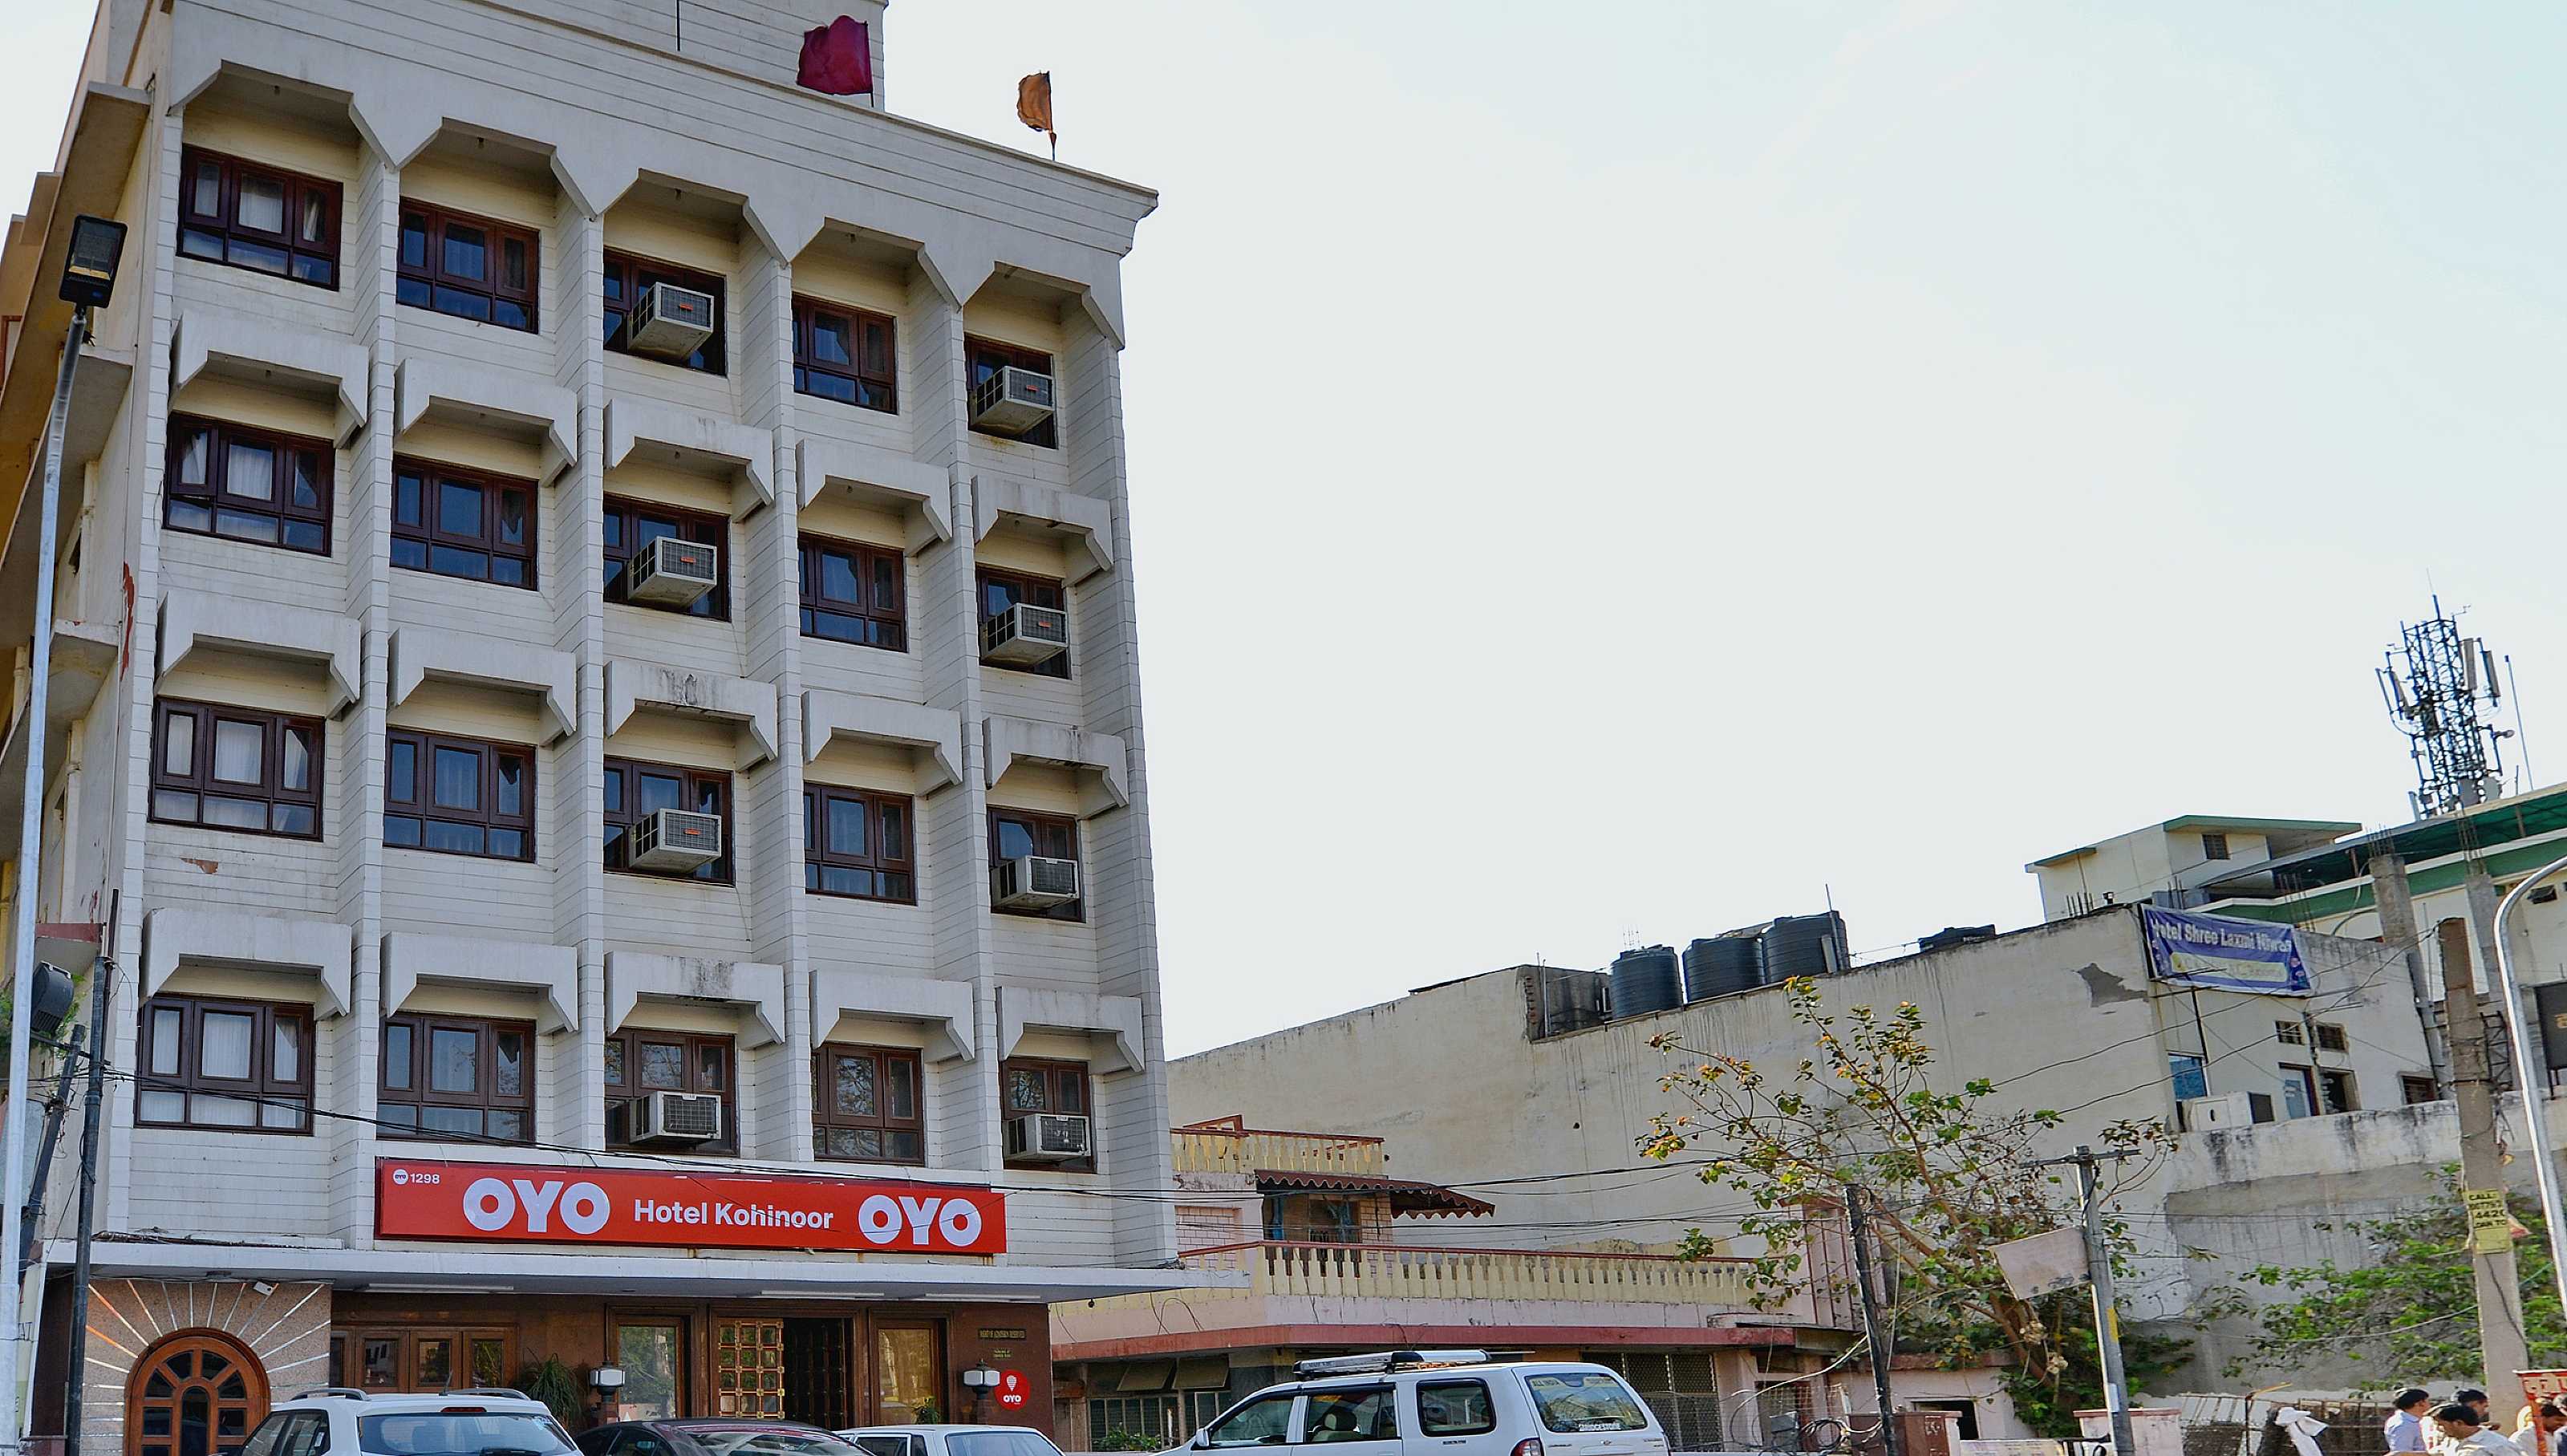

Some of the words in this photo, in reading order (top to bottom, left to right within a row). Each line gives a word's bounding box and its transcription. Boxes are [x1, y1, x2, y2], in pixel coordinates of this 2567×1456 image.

[2151, 918, 2182, 941] Hotel
[2184, 923, 2220, 946] Shree
[410, 1173, 440, 1185] 1298
[463, 1178, 611, 1235] OYO
[635, 1199, 708, 1225] Hotel
[715, 1203, 834, 1230] Kohinoor
[858, 1194, 983, 1247] OYO
[1003, 1394, 1022, 1403] OYO
